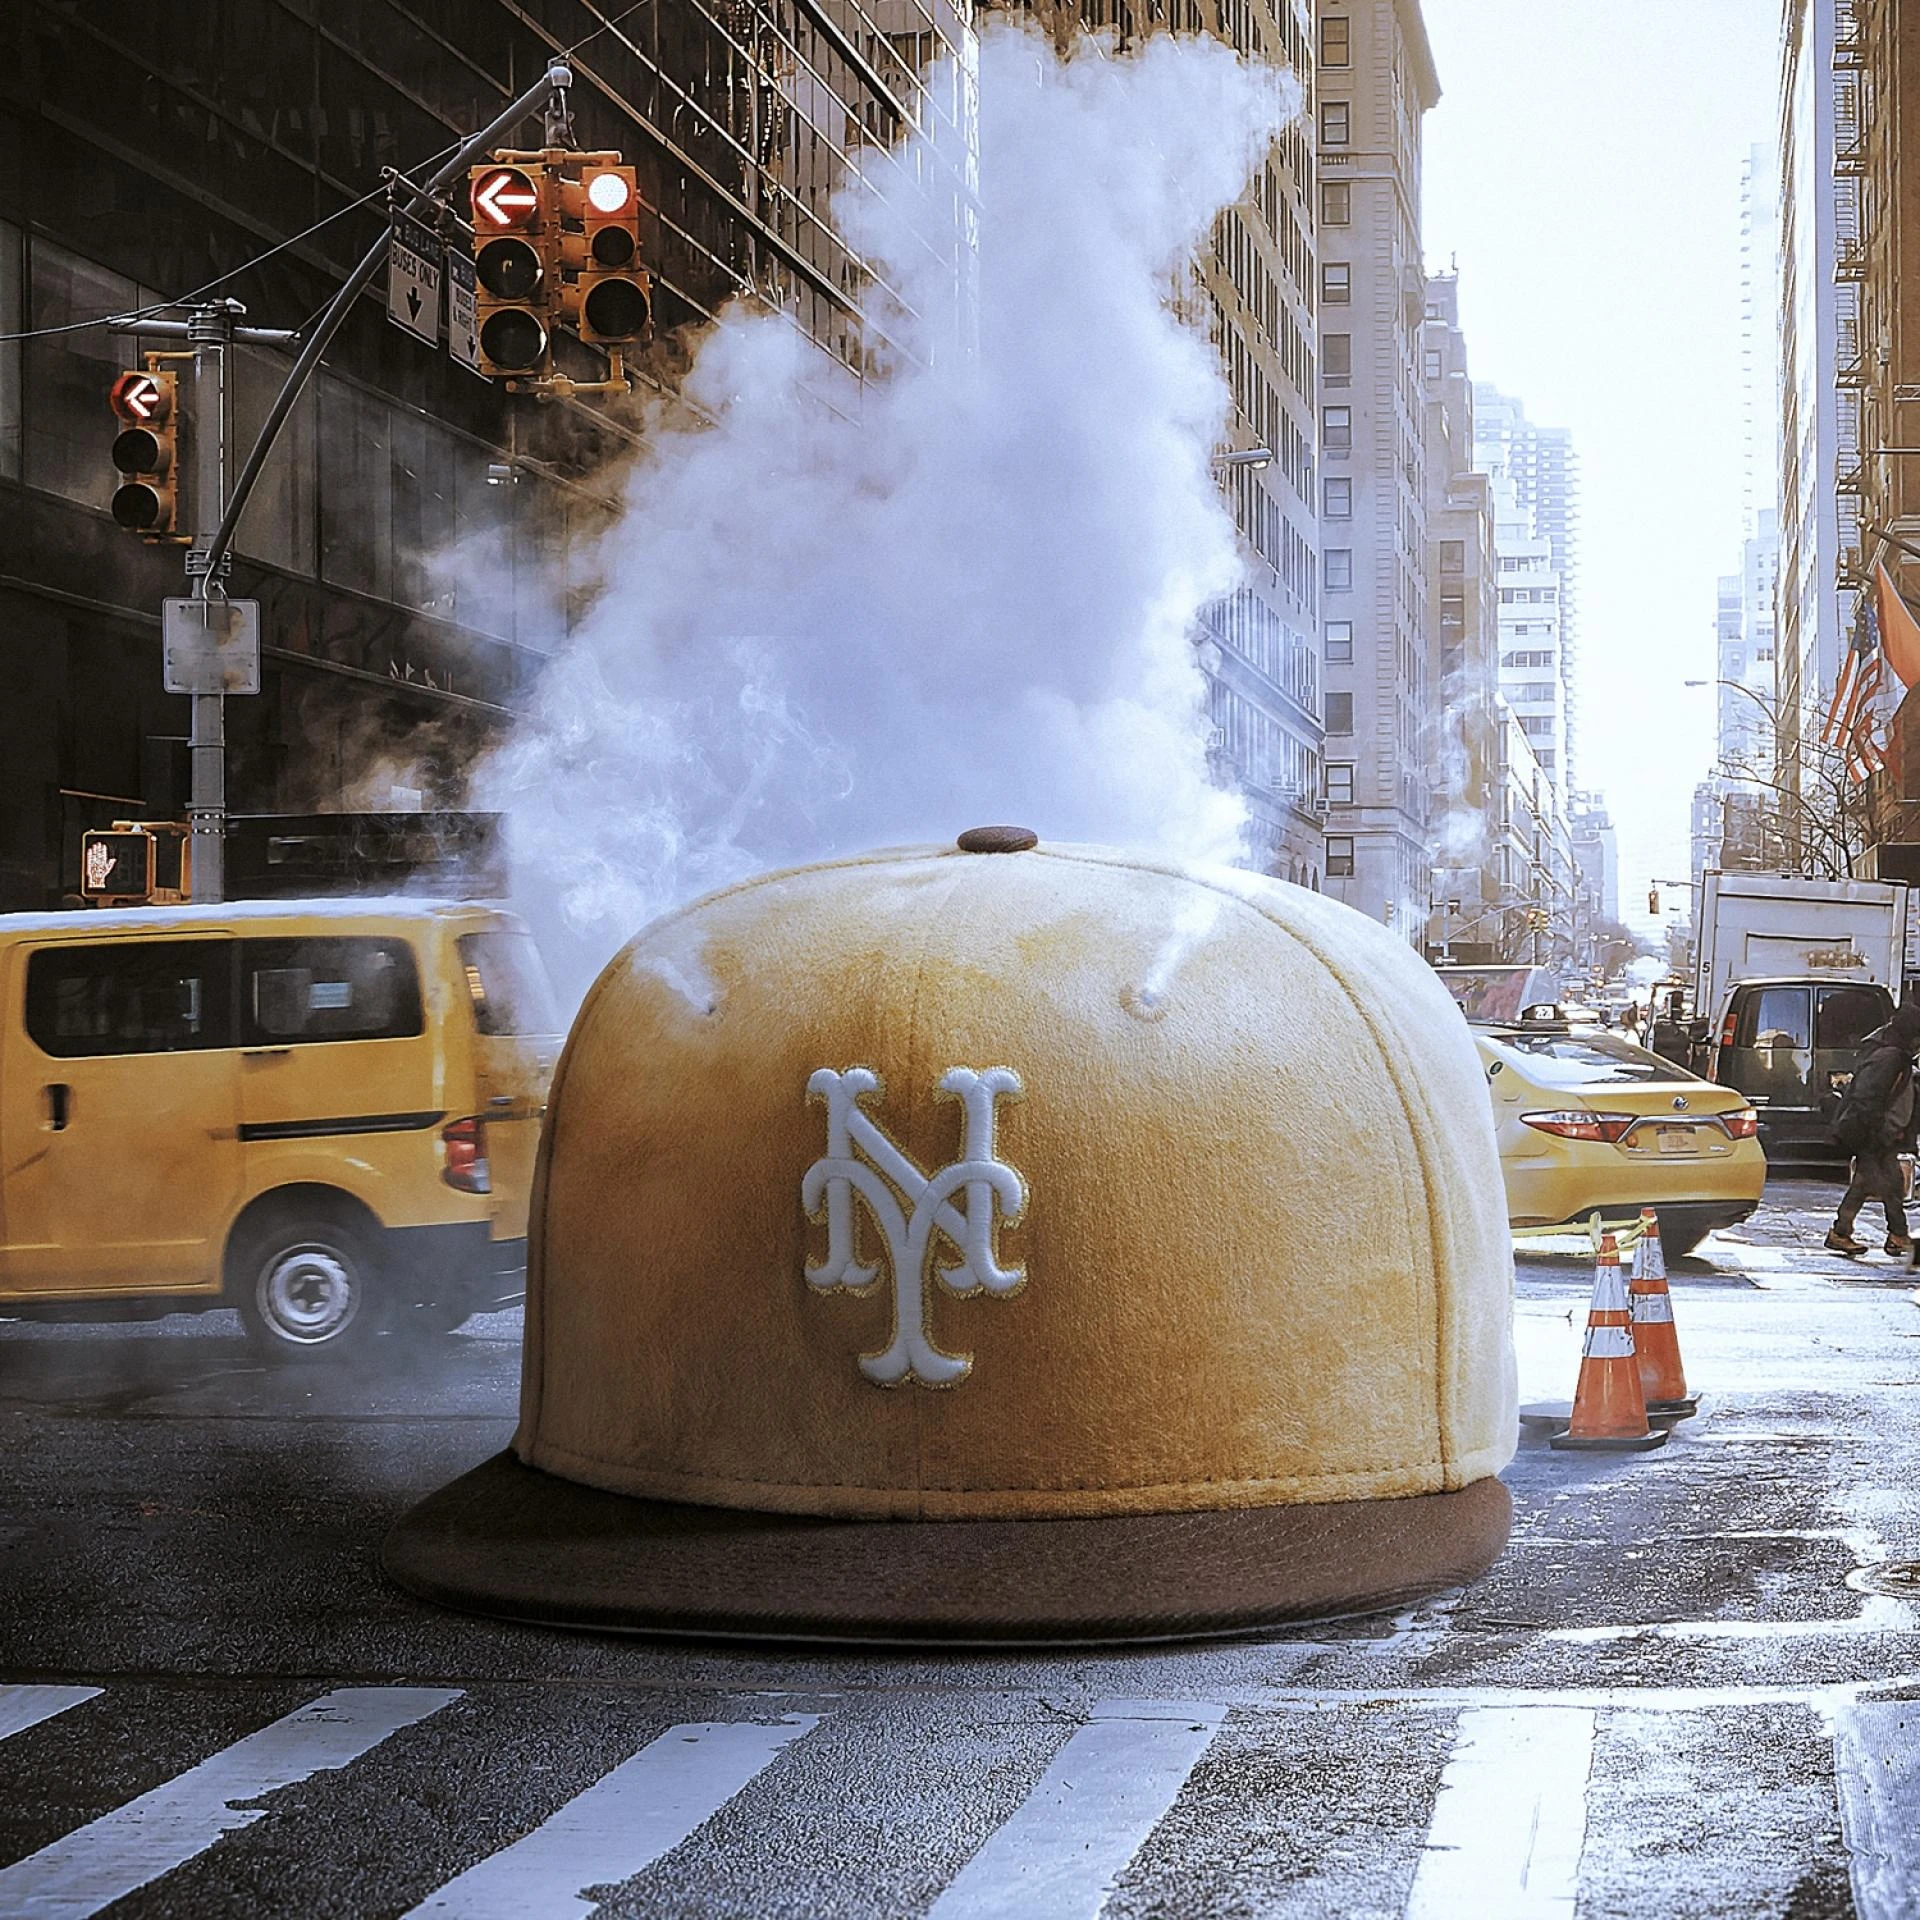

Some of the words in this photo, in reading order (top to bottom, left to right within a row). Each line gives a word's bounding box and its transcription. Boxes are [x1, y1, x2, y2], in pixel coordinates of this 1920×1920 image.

[392, 242, 417, 278] BUSES
[419, 262, 439, 291] ONLY
[1702, 961, 1711, 974] 5
[802, 1066, 1027, 1388] NY
